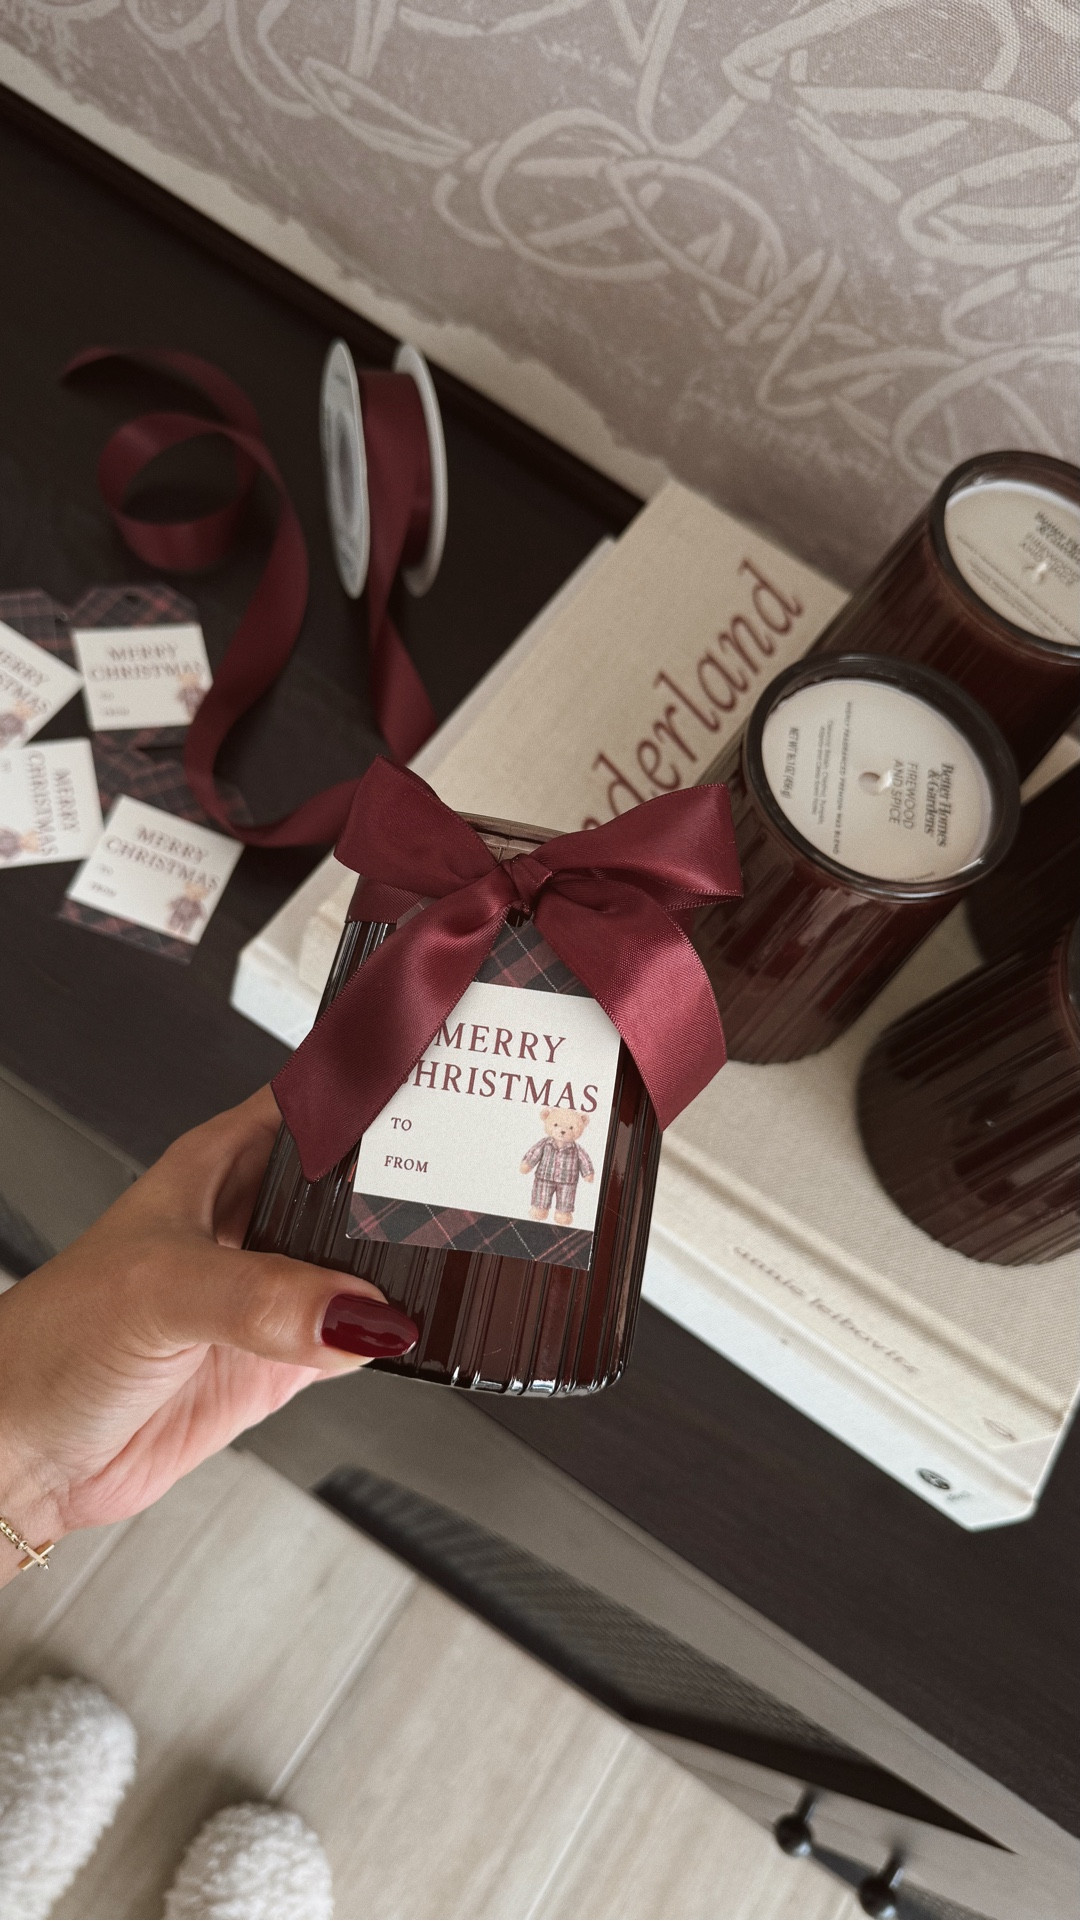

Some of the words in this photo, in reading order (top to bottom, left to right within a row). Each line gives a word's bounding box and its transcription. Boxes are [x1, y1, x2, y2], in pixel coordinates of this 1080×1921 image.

[581, 557, 804, 830] derland
[892, 759, 904, 787] AND
[939, 763, 955, 801] Better
[889, 790, 903, 825] SPICE
[903, 762, 918, 830] FIREWOOD
[937, 802, 951, 848] Homes
[434, 1020, 566, 1064] MERRY
[402, 1059, 599, 1113] HRISTMAS
[390, 1117, 412, 1132] TO
[384, 1155, 428, 1173] FROM
